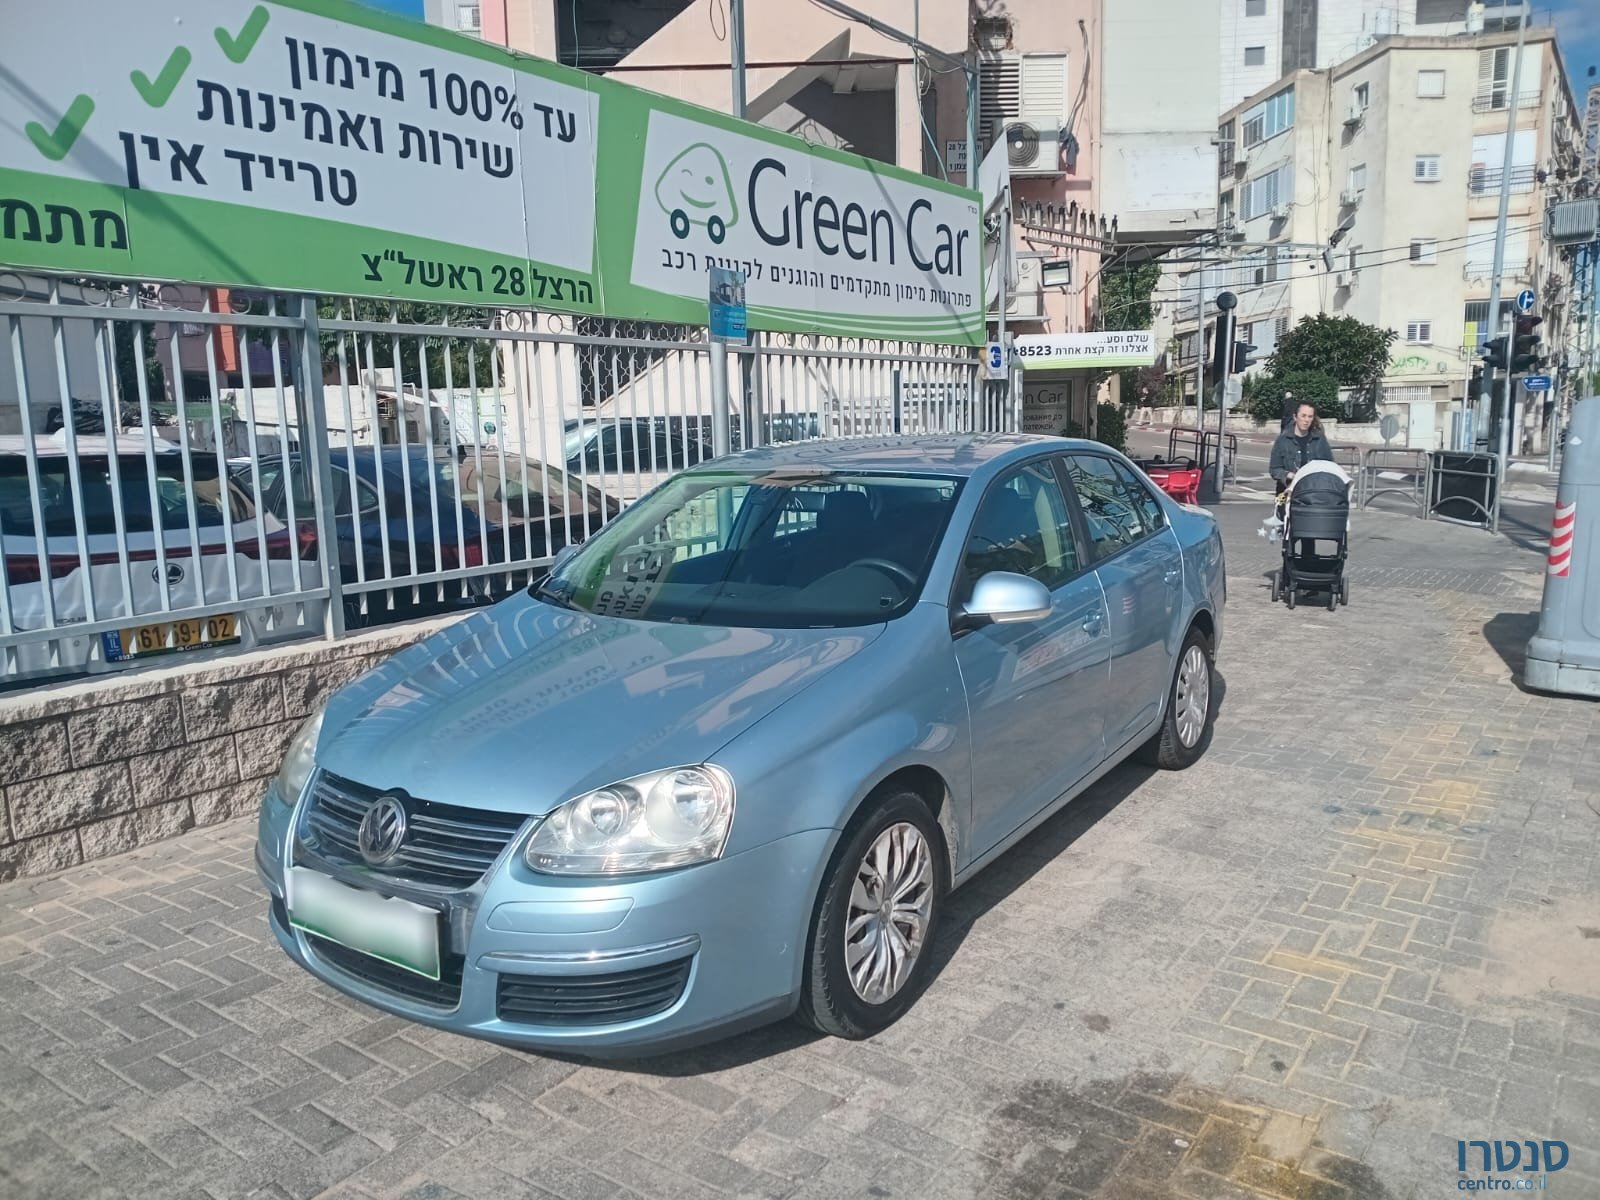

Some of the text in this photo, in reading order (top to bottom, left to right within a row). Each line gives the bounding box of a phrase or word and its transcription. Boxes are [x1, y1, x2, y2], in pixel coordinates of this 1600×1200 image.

[285, 36, 577, 143] עד 100% מימון
[197, 79, 514, 178] שירות ואמינות
[118, 130, 358, 206] טרייד אין
[748, 157, 969, 277] Green Car
[662, 248, 697, 271] רכב
[491, 264, 525, 297] 28
[532, 267, 593, 304] הרצל
[771, 265, 824, 288] והוגנים
[830, 274, 891, 299] מתקדמים
[896, 284, 926, 303] מימון
[930, 288, 972, 307] פתרונות
[1108, 345, 1119, 353] זה
[1121, 343, 1149, 353] אצלנו
[1126, 333, 1149, 343] שלם
[1055, 347, 1081, 356] אחרת
[1084, 346, 1105, 356] קצת
